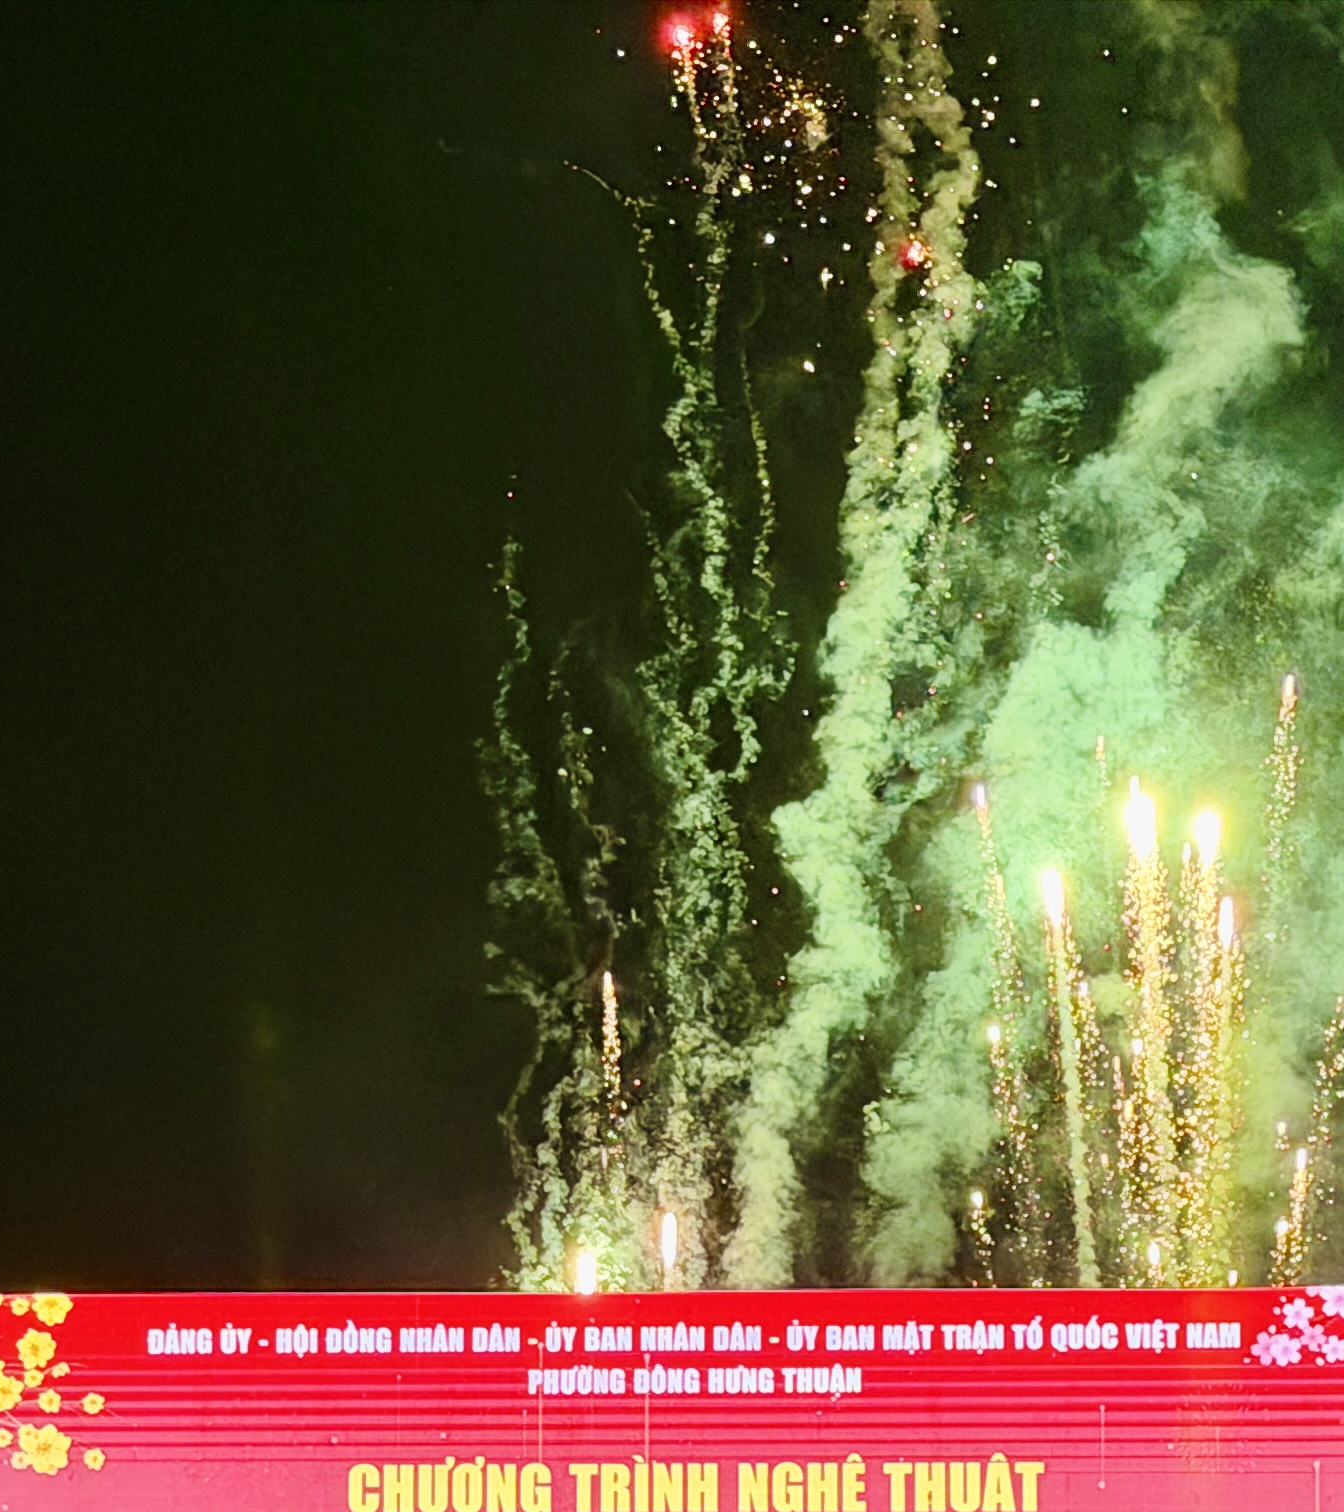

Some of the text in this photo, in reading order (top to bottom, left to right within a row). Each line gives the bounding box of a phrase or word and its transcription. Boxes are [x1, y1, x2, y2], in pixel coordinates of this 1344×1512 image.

[147, 1322, 213, 1355] ĐẢNG
[220, 1322, 252, 1355] ỦY
[275, 1322, 319, 1357] HỘI
[325, 1320, 392, 1354] ĐỒNG
[399, 1322, 465, 1354] NHÂN
[472, 1322, 521, 1353] DÂN
[545, 1320, 578, 1353] ỦY
[584, 1326, 633, 1352] BAN
[640, 1321, 705, 1352] NHÂN
[713, 1321, 762, 1352] DÂN
[786, 1318, 819, 1352] ỦY
[825, 1325, 875, 1351] BAN
[882, 1318, 935, 1355] MẶT
[940, 1318, 1005, 1355] TRẬN
[1011, 1316, 1044, 1350] TỔ
[1052, 1316, 1118, 1354] QUỐC
[1125, 1316, 1180, 1353] VIỆT
[1186, 1322, 1241, 1349] NAM
[527, 1362, 862, 1399] PHƯỜNG ĐÔNG HƯNG THUẬN
